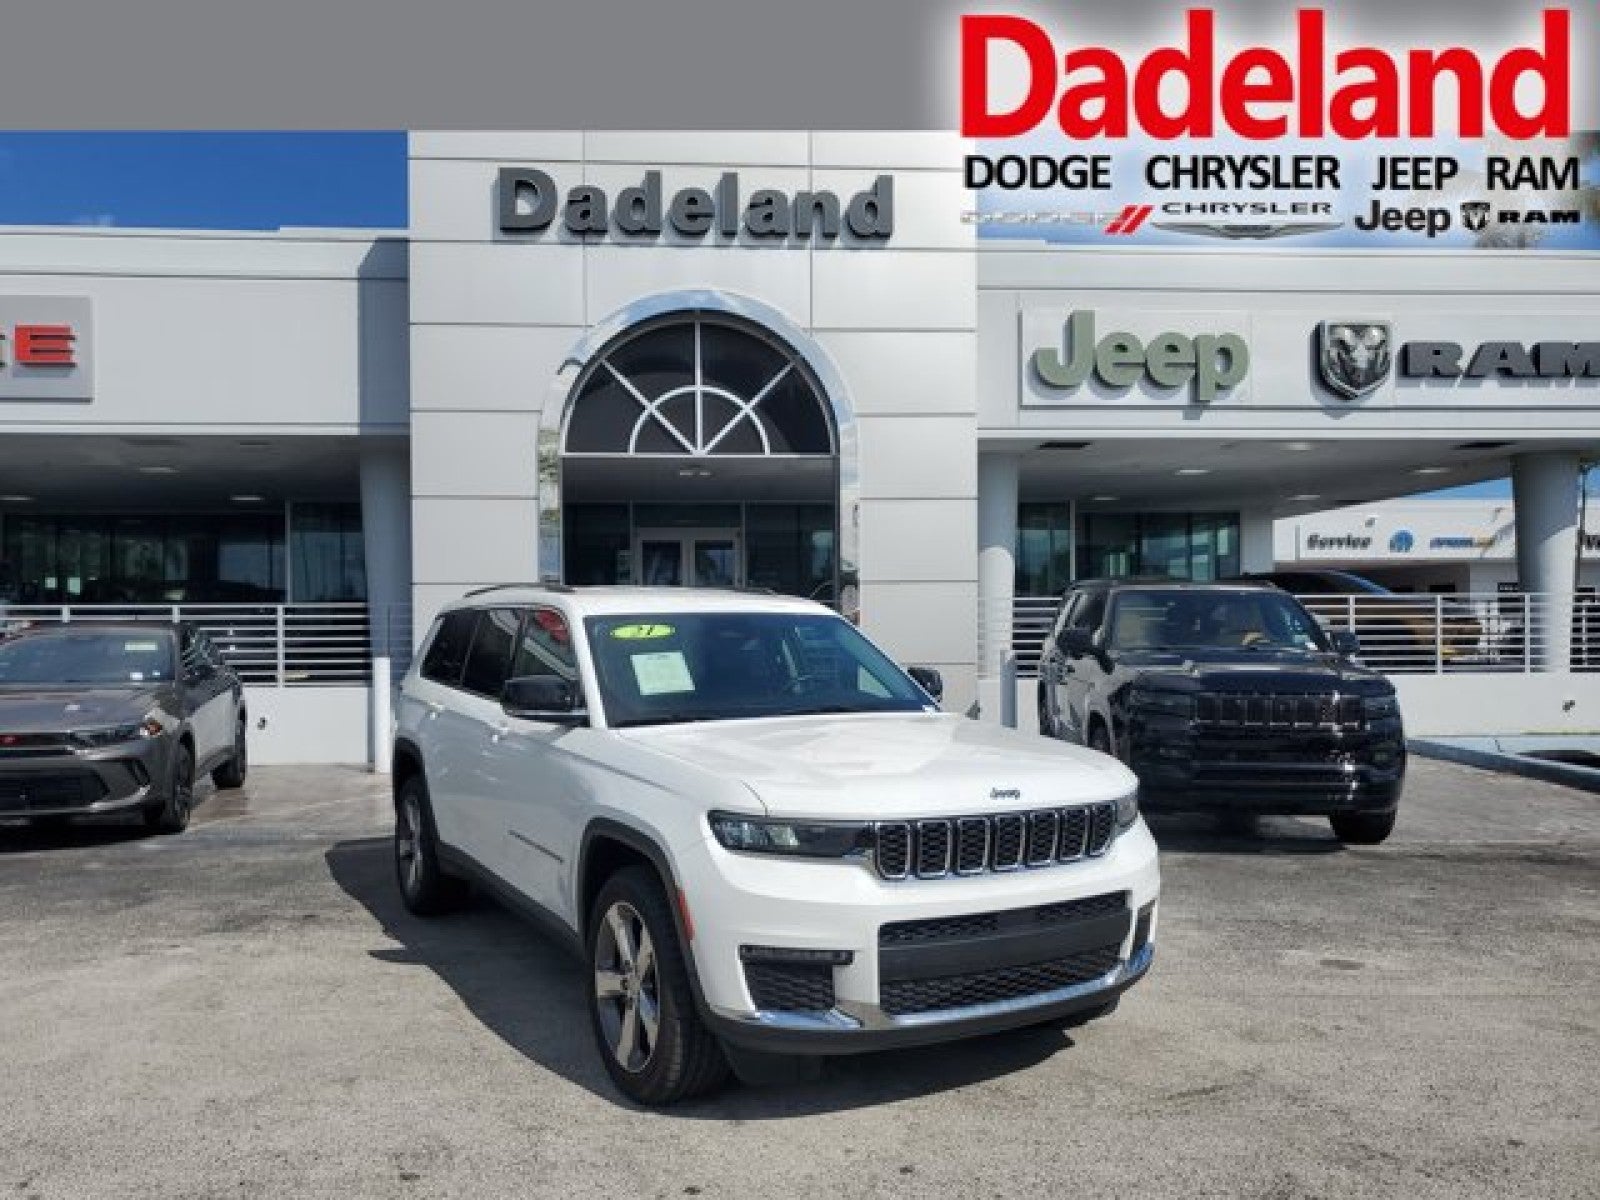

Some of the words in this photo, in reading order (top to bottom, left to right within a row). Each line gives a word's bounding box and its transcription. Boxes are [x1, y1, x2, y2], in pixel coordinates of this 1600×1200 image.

[497, 166, 894, 243] Dadeland
[0, 324, 77, 368] E
[1034, 309, 1250, 403] Jeep
[1400, 340, 1600, 380] RAM
